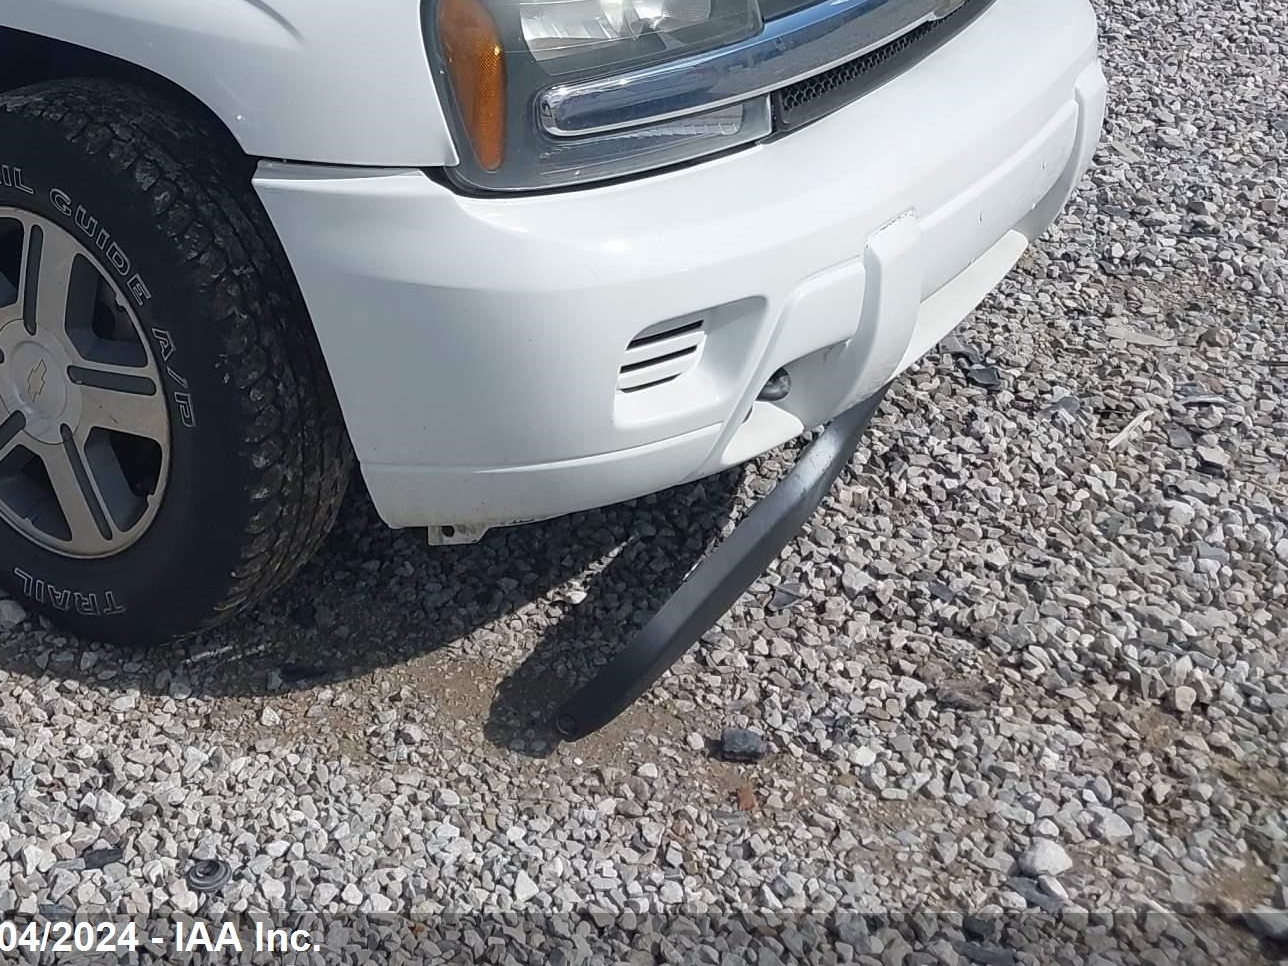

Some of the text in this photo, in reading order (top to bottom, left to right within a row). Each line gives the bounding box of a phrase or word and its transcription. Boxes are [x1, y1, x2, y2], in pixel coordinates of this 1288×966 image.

[49, 188, 151, 306] GUIDE
[152, 327, 197, 428] A/P
[14, 567, 127, 616] TRAIL
